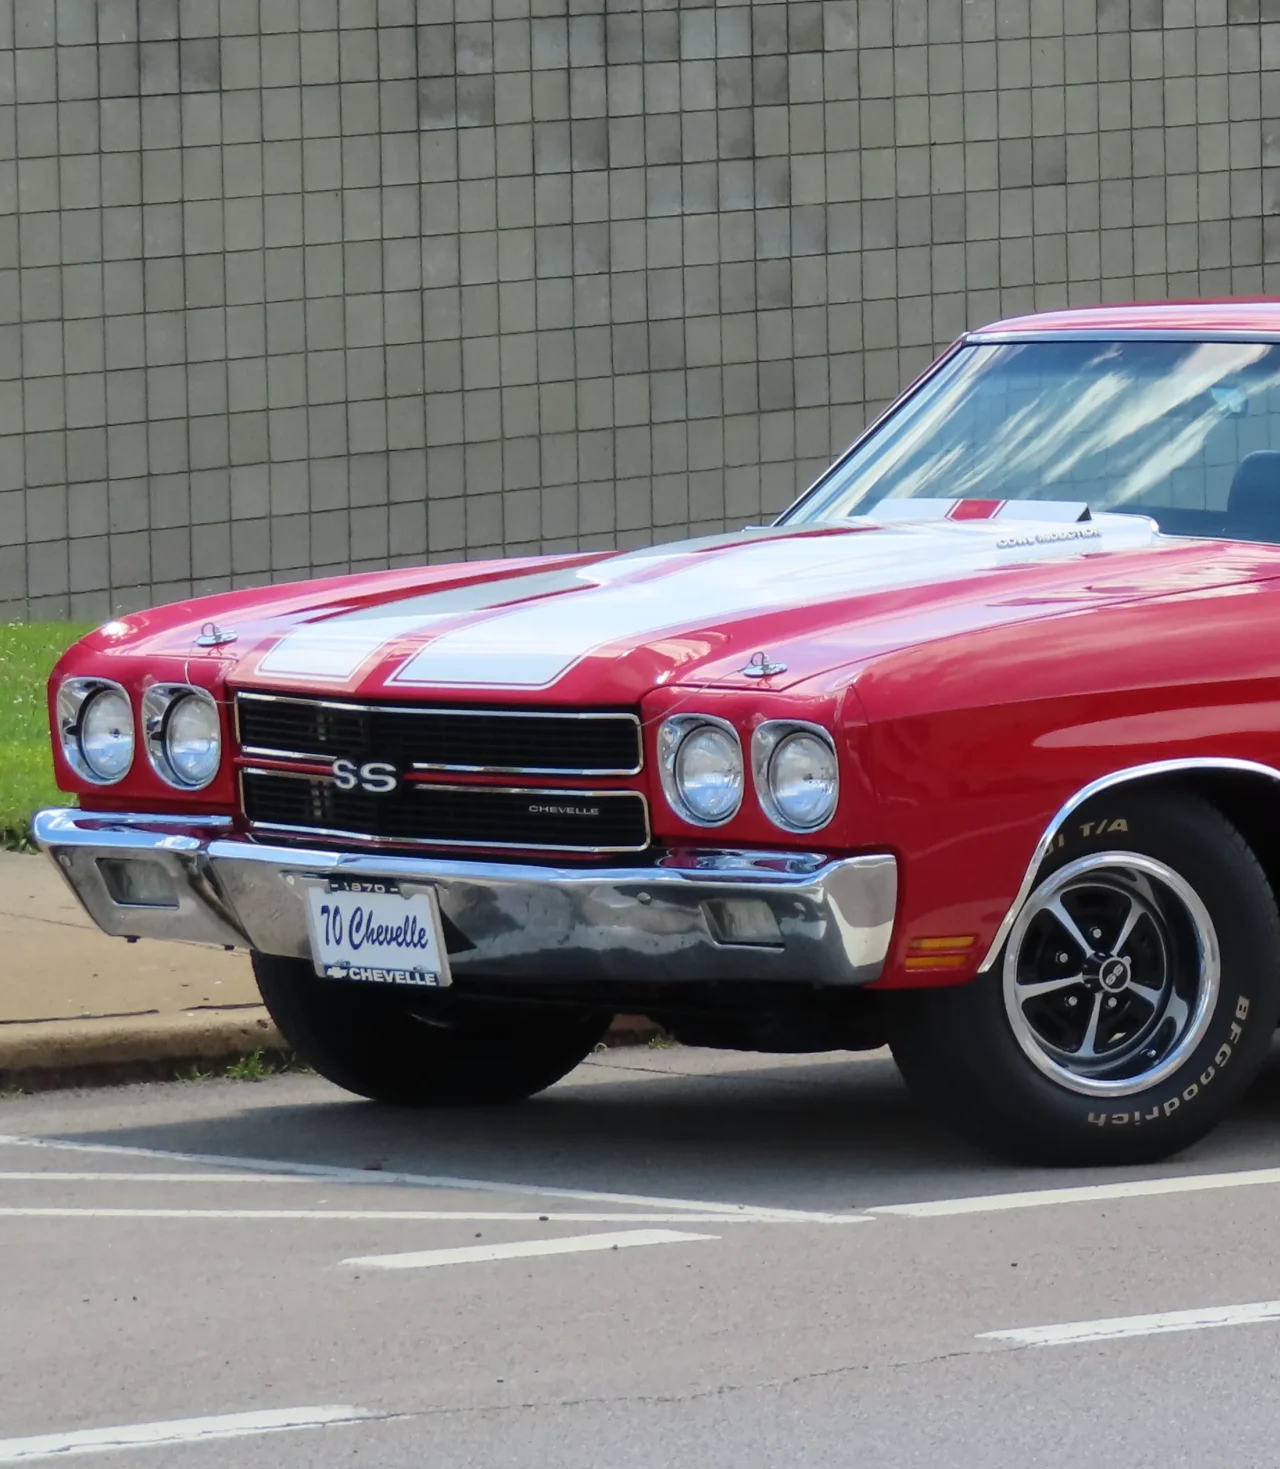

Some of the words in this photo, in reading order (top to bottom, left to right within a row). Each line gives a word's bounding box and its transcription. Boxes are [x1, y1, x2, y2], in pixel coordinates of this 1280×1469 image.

[332, 759, 398, 792] SS
[528, 804, 600, 816] CHEVELLE
[1079, 818, 1129, 838] T/A
[320, 904, 344, 947] 70
[348, 905, 429, 951] Chevelle
[348, 967, 437, 986] CHEVELLE
[1087, 995, 1251, 1127] BFGoodrich
